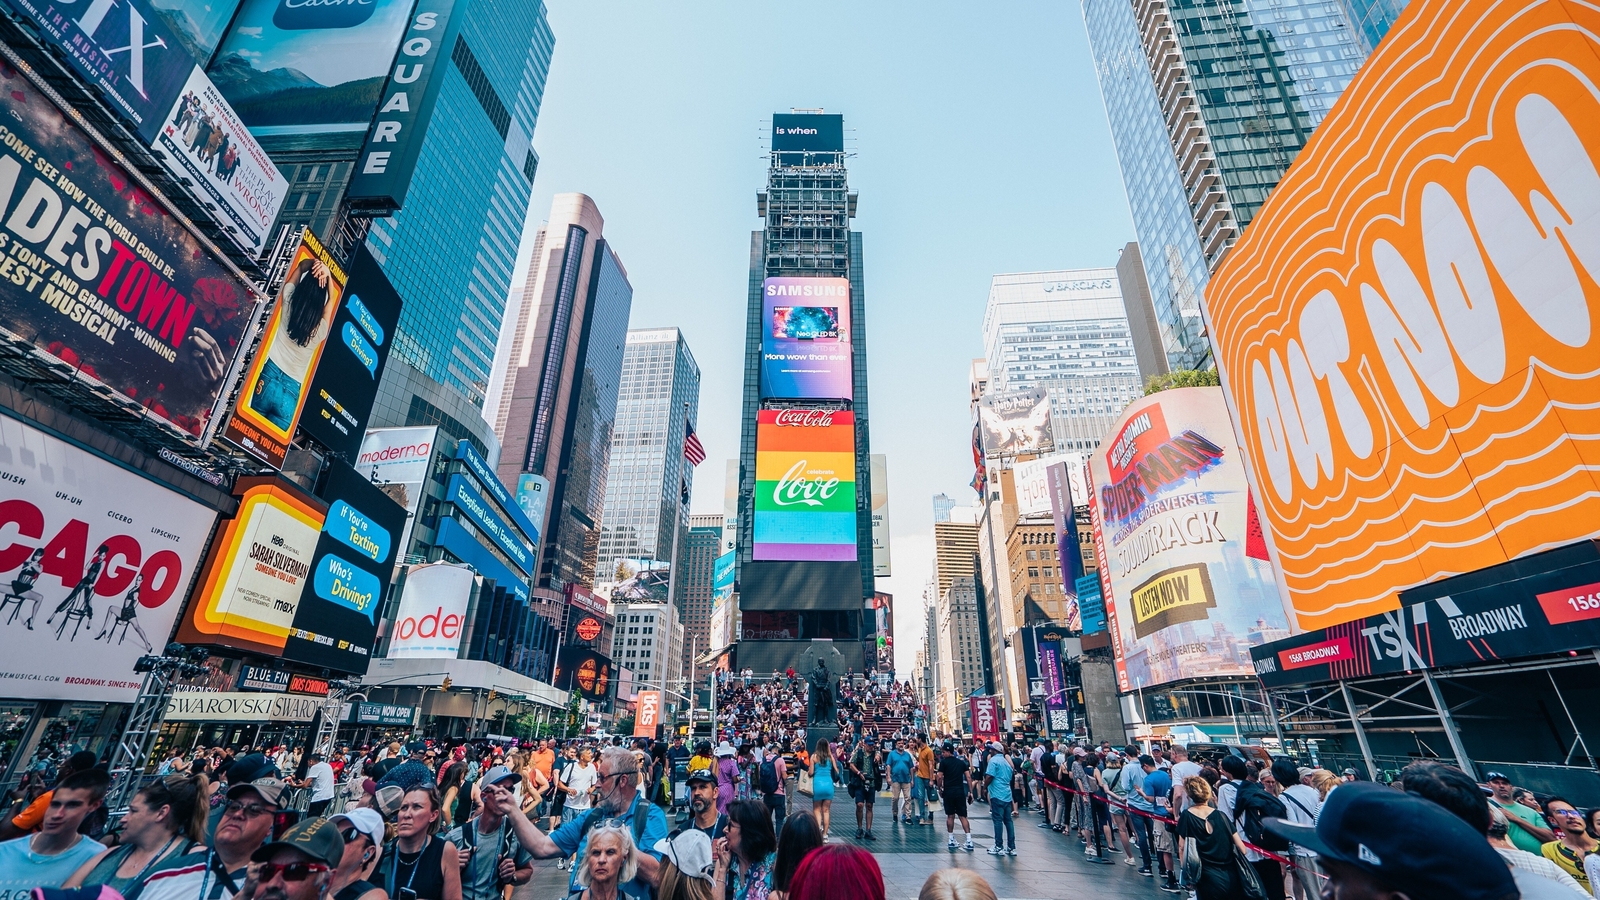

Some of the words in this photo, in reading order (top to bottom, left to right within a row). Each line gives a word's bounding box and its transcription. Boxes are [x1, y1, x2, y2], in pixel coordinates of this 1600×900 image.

[46, 5, 70, 33] THE
[72, 33, 121, 86] MUSICAL
[37, 14, 62, 40] THEATRE
[78, 56, 92, 72] 47TH
[90, 68, 99, 78] ST
[99, 77, 143, 124] SIXONBROADWAY.COM
[362, 12, 438, 174] SQUARE
[202, 91, 214, 105] AND
[213, 104, 248, 150] INTERNATIONAL
[247, 147, 274, 182] PHENOMENON
[206, 86, 236, 124] BROADWAY'S
[255, 148, 269, 168] SMASH
[267, 164, 276, 176] HIT
[776, 126, 785, 134] is
[787, 126, 817, 134] when
[174, 150, 188, 165] NEW
[186, 162, 204, 182] WORLD
[203, 180, 220, 201] STAGES
[242, 226, 257, 242] STREET
[238, 168, 255, 190] THAT
[254, 188, 275, 216] GOES
[245, 164, 257, 180] THE
[257, 178, 276, 204] PLAY
[0, 125, 37, 163] COME
[34, 157, 60, 182] SEE
[56, 174, 86, 203] HOW
[86, 197, 106, 222] THE
[104, 213, 138, 248] WORLD
[136, 242, 165, 275] COULD
[162, 266, 176, 282] BE.
[234, 176, 271, 228] WRONG
[304, 229, 323, 256] SARAH
[320, 249, 348, 287] SILVERMAN
[50, 270, 79, 296] AND
[767, 285, 846, 297] SAMSUNG
[1056, 280, 1112, 291] BARCLAYS
[1252, 288, 1374, 502] OUT
[1360, 93, 1600, 429] NOW
[40, 283, 118, 345] MUSICAL
[359, 315, 378, 341] Texting
[349, 325, 362, 344] Who's
[350, 339, 373, 367] Driving?
[775, 409, 835, 427] Coca-Cola
[994, 398, 1014, 413] Harry
[1014, 396, 1035, 410] Potter
[230, 417, 260, 443] SOMEONE
[260, 435, 272, 449] YOU
[271, 442, 286, 459] LOVE
[1122, 412, 1152, 446] BOOMIN
[241, 437, 254, 449] HBO
[253, 446, 269, 459] ORIGINAL
[359, 442, 430, 463] moderna
[0, 470, 26, 485] UISH
[772, 460, 840, 507] love
[1102, 430, 1224, 521] SPIDER-MAN
[55, 491, 83, 506] UH-UH
[107, 510, 133, 525] CICERO
[340, 505, 347, 518] If
[349, 510, 368, 531] You're
[458, 485, 483, 519] Exceptional
[483, 511, 498, 536] Leaders
[500, 529, 519, 557] Exceptional
[1091, 506, 1100, 536] FREE
[1114, 526, 1130, 545] ACROSS
[1138, 492, 1206, 525] SPIDER-VERSE
[150, 527, 180, 543] LIPSCHITZ
[271, 534, 284, 547] HBO
[283, 543, 300, 555] ORIGINAL
[349, 527, 379, 559] Texting
[1117, 510, 1226, 578] SOUNDTRACK
[250, 542, 276, 566] SARAH
[272, 552, 309, 579] SILVERMAN
[255, 562, 277, 577] SOMEONE
[277, 570, 286, 581] YOU
[286, 575, 297, 585] LOVE
[329, 559, 353, 581] Who's
[1095, 534, 1114, 605] CHOCOLATE
[237, 587, 245, 595] NEW
[245, 589, 260, 598] COMEDY
[260, 594, 271, 602] SPECIAL
[252, 598, 270, 607] STREAMING
[273, 599, 295, 614] max
[331, 578, 372, 611] Driving?
[1138, 581, 1161, 618] LISTEN
[1160, 574, 1189, 608] NOW
[1173, 642, 1207, 657] THEATERS
[1361, 608, 1426, 670] TSX
[1448, 603, 1528, 640] BROADWAY
[1288, 653, 1303, 663] 1568
[1303, 645, 1340, 661] BROADWAY
[65, 676, 106, 686] BROADWAY.
[107, 680, 126, 688] SINCE
[248, 668, 273, 682] BLUE
[276, 672, 293, 685] FIN
[293, 678, 308, 692] DOS
[167, 698, 274, 716] SWAROVSKI
[382, 706, 396, 716] NOW
[396, 707, 411, 718] OPEN
[641, 694, 657, 726] tkts
[977, 700, 993, 732] tkts
